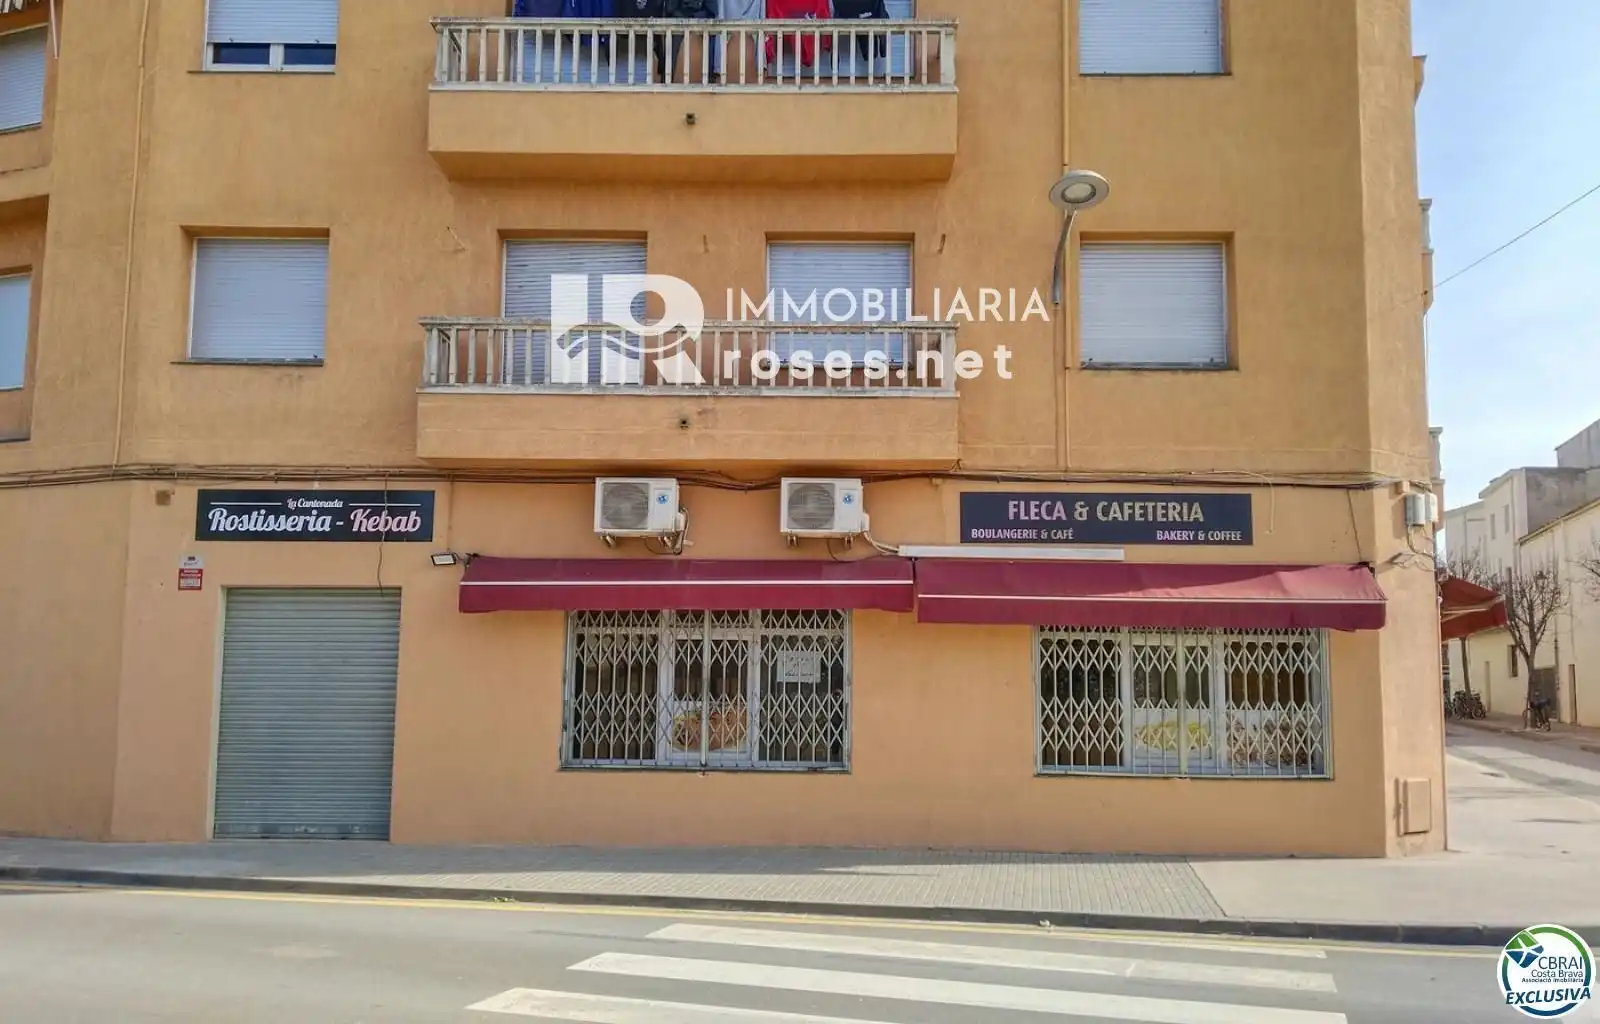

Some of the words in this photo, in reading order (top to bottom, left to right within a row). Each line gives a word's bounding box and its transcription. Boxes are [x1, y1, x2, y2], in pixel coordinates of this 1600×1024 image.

[287, 498, 297, 510] La
[297, 498, 343, 508] Cantonada
[1008, 500, 1067, 521] FLECA
[1074, 501, 1089, 521] &
[1097, 501, 1205, 522] CAFETERIA
[208, 508, 331, 532] Rostisseria
[351, 508, 422, 533] Kebab
[971, 528, 1038, 539] BOULANGERIE
[1040, 528, 1048, 540] &
[1050, 527, 1074, 540] CAFÉ
[1156, 530, 1195, 541] BAKERY
[1198, 530, 1205, 541] &
[1208, 530, 1242, 542] COFFEE
